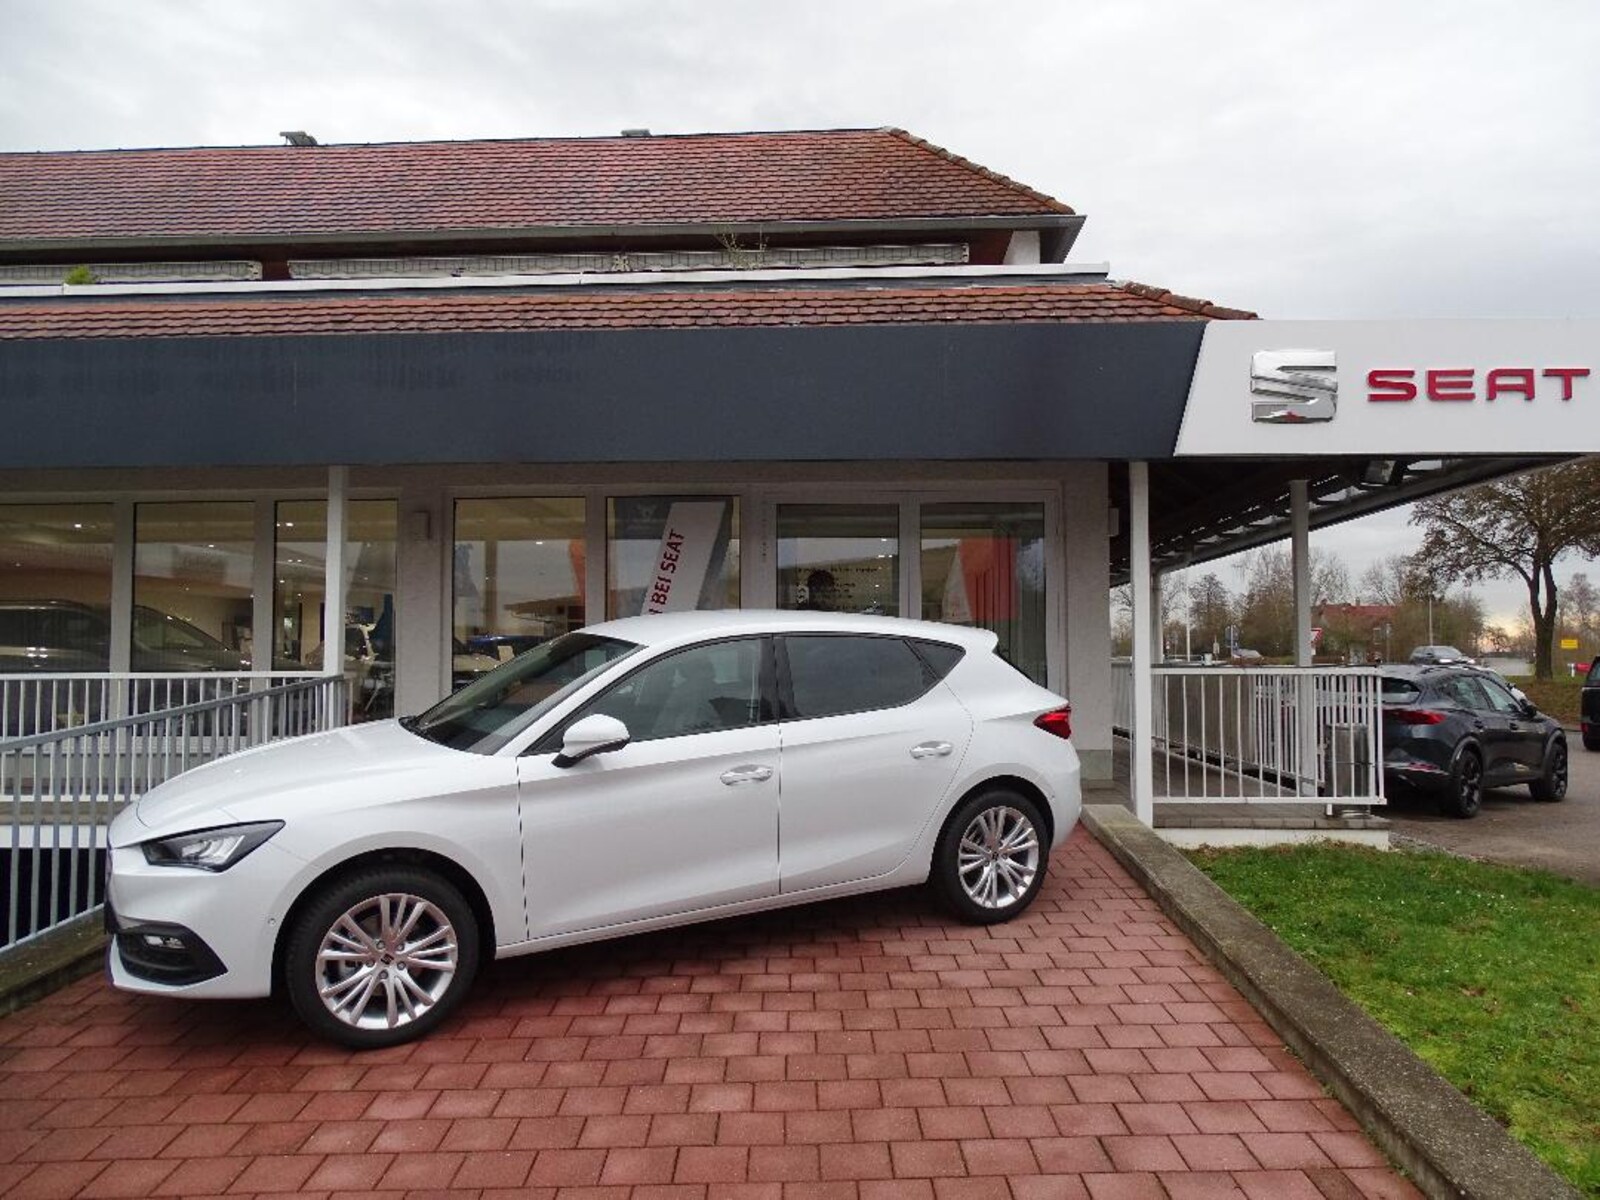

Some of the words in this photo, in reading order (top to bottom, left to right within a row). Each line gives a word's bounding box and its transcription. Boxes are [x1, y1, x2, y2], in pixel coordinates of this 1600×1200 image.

[1367, 368, 1590, 401] SEAT
[660, 528, 684, 574] SEAT
[651, 575, 672, 605] BEI
